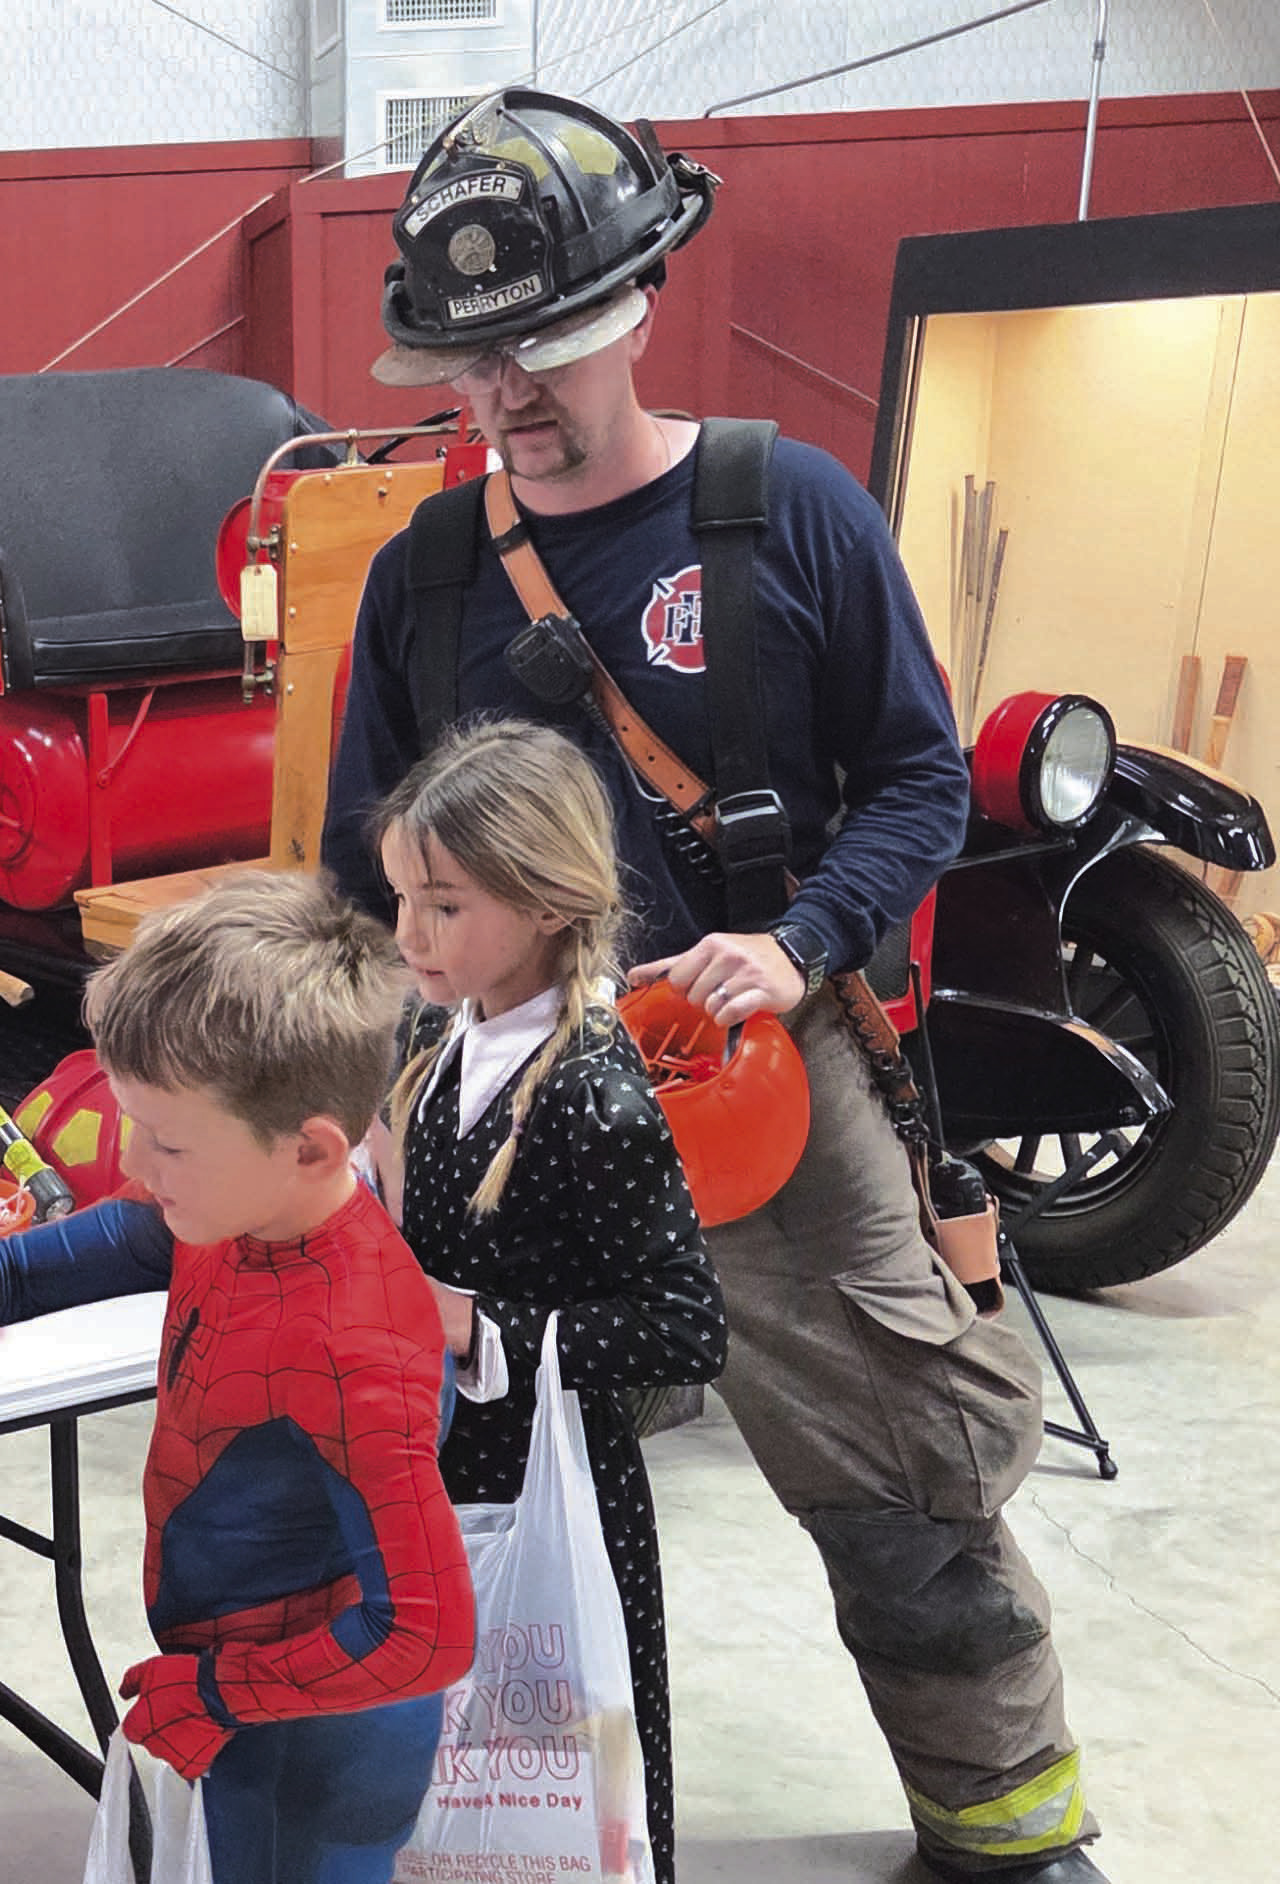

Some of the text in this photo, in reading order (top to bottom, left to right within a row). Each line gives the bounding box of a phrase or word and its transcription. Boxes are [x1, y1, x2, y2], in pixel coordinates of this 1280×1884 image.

[416, 175, 506, 222] SCHAFER
[452, 279, 536, 315] PERRYTON
[479, 1623, 565, 1674] YOU
[475, 1679, 572, 1730] YOU
[483, 1735, 579, 1781] YOU
[437, 1794, 484, 1809] Have
[499, 1792, 541, 1808] Nice
[546, 1792, 583, 1811] Day
[431, 1853, 452, 1867] OR
[455, 1853, 518, 1871] RECYCLE
[521, 1855, 556, 1871] THIS
[559, 1855, 592, 1873] BAG
